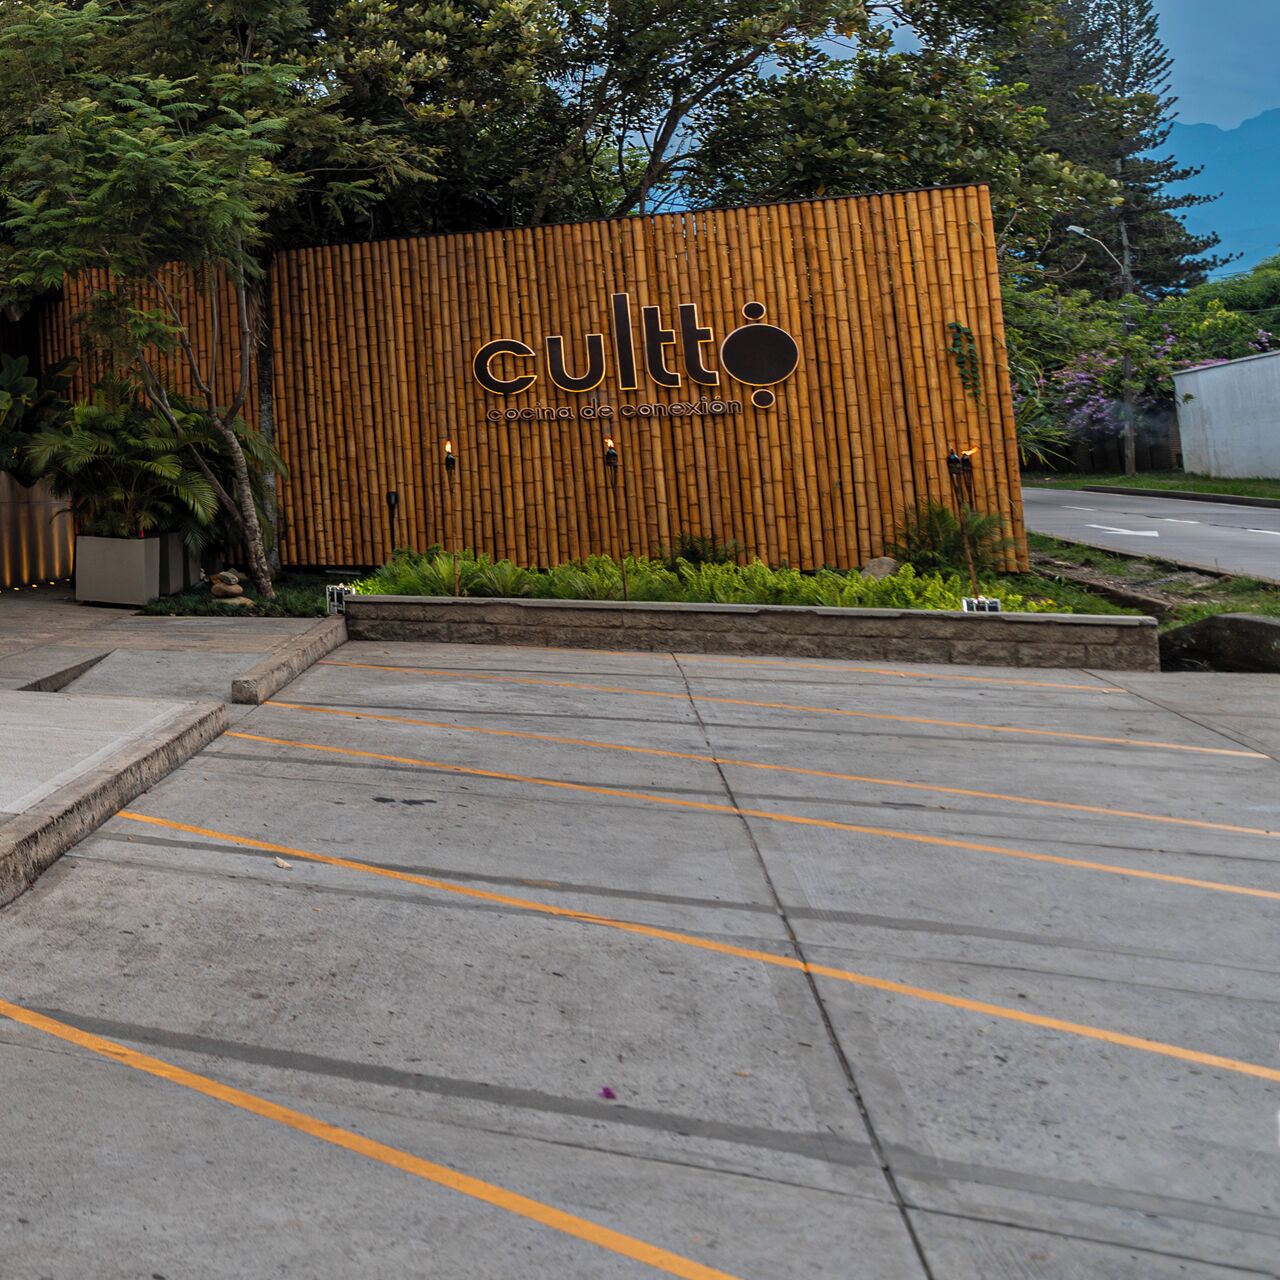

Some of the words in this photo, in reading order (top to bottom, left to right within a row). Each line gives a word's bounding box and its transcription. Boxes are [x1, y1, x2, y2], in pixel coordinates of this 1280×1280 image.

[486, 402, 575, 421] cocina
[580, 397, 615, 420] de
[621, 394, 743, 418] conexión
